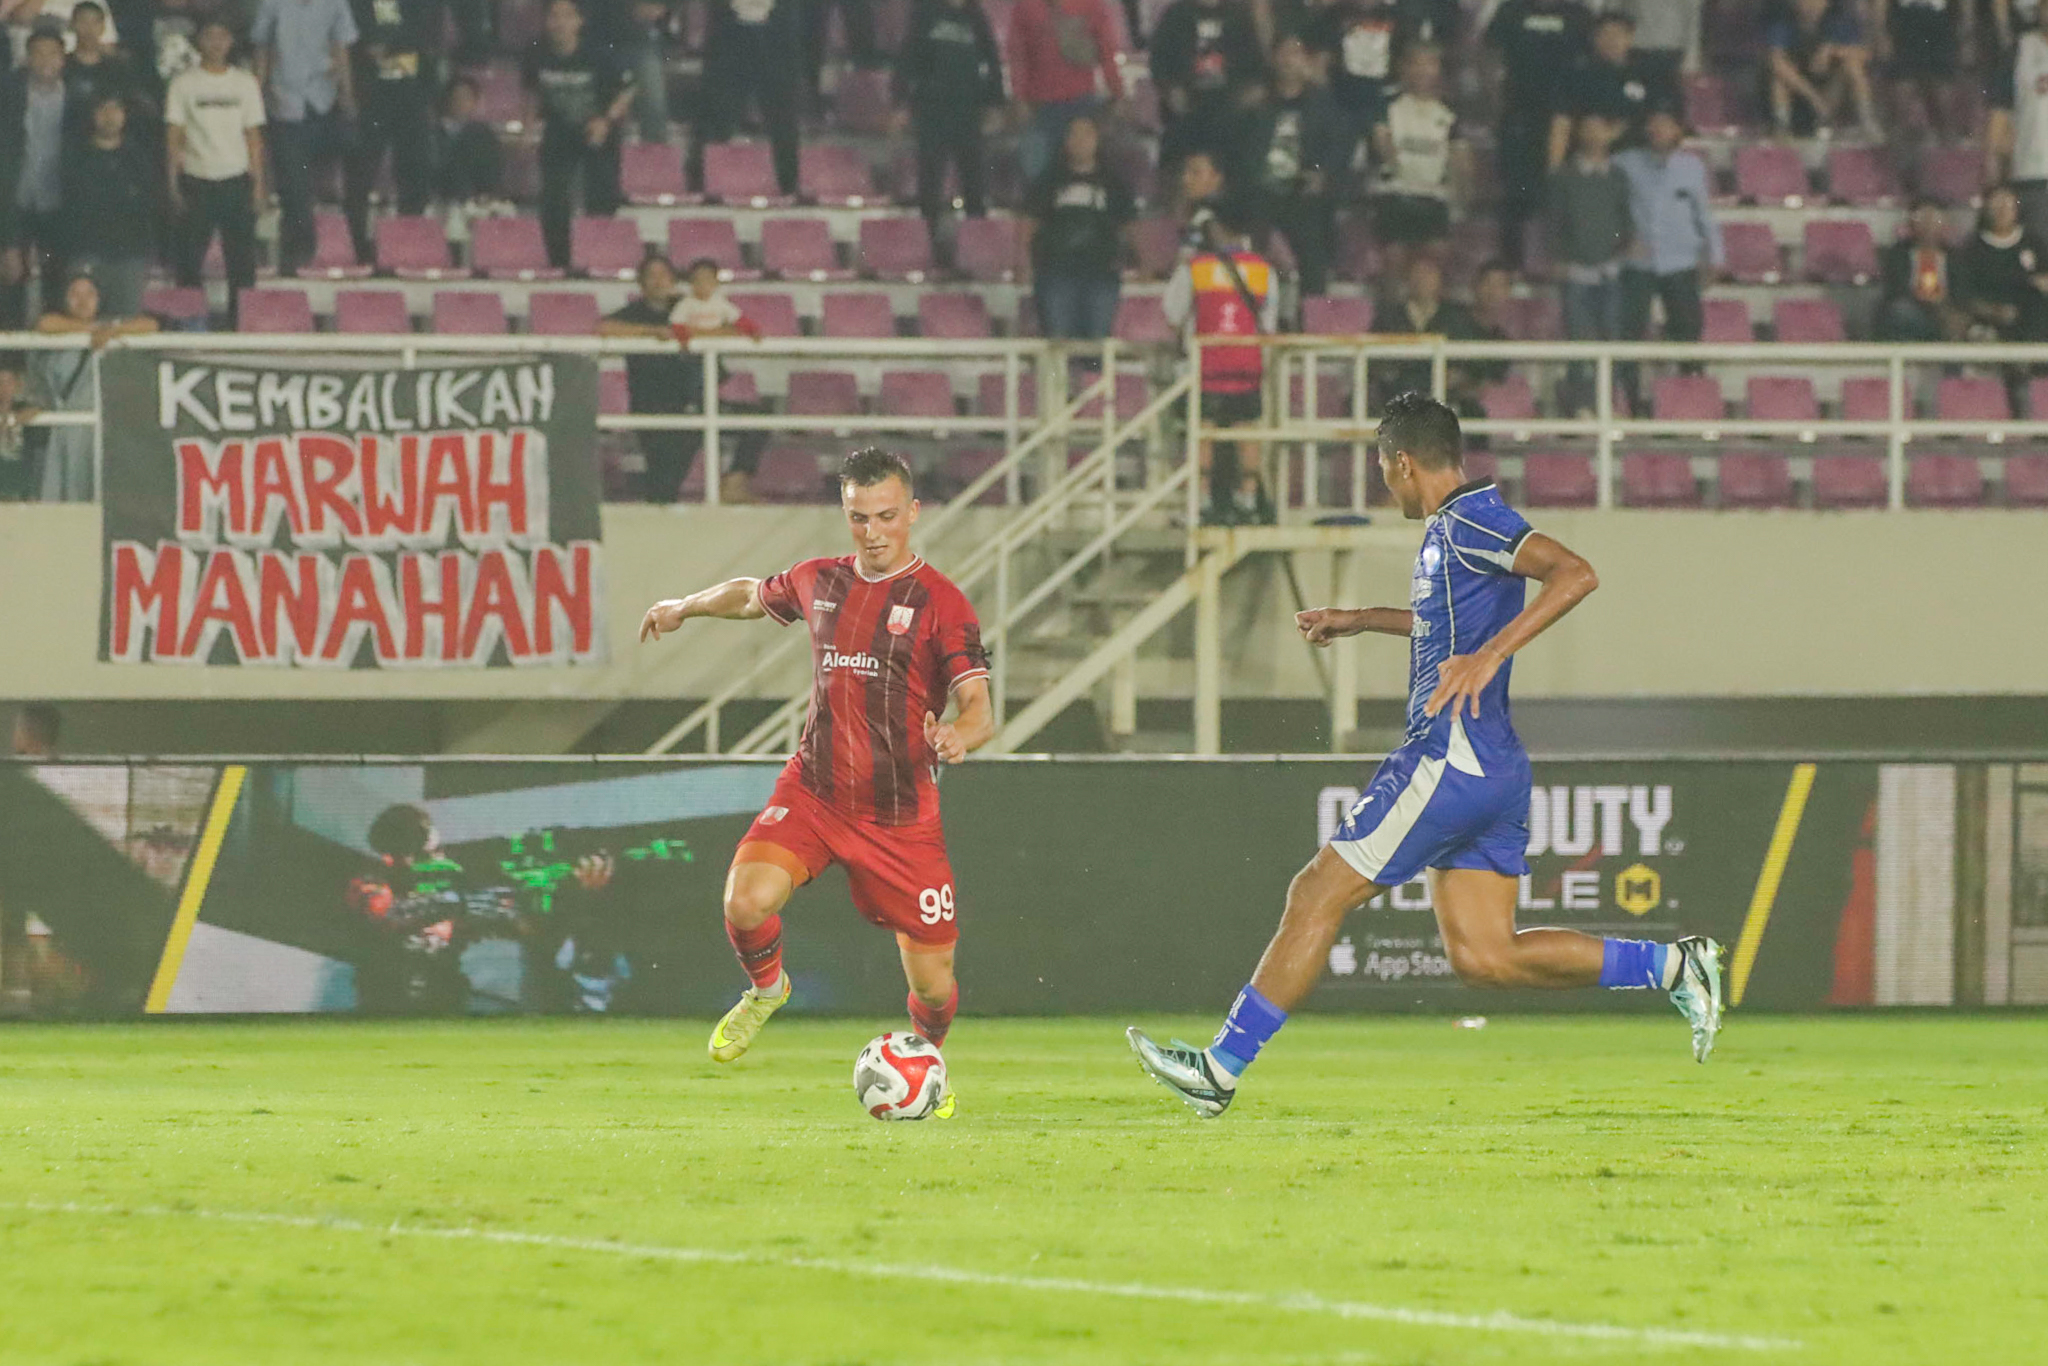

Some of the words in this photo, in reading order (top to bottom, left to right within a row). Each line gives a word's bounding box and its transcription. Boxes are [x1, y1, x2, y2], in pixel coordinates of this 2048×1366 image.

[158, 361, 555, 433] KEMBALIKAN
[173, 427, 549, 549] MARWAH
[110, 539, 600, 666] MANAHAN
[822, 651, 880, 670] Aladin
[918, 883, 955, 925] 99
[1364, 951, 1409, 981] App
